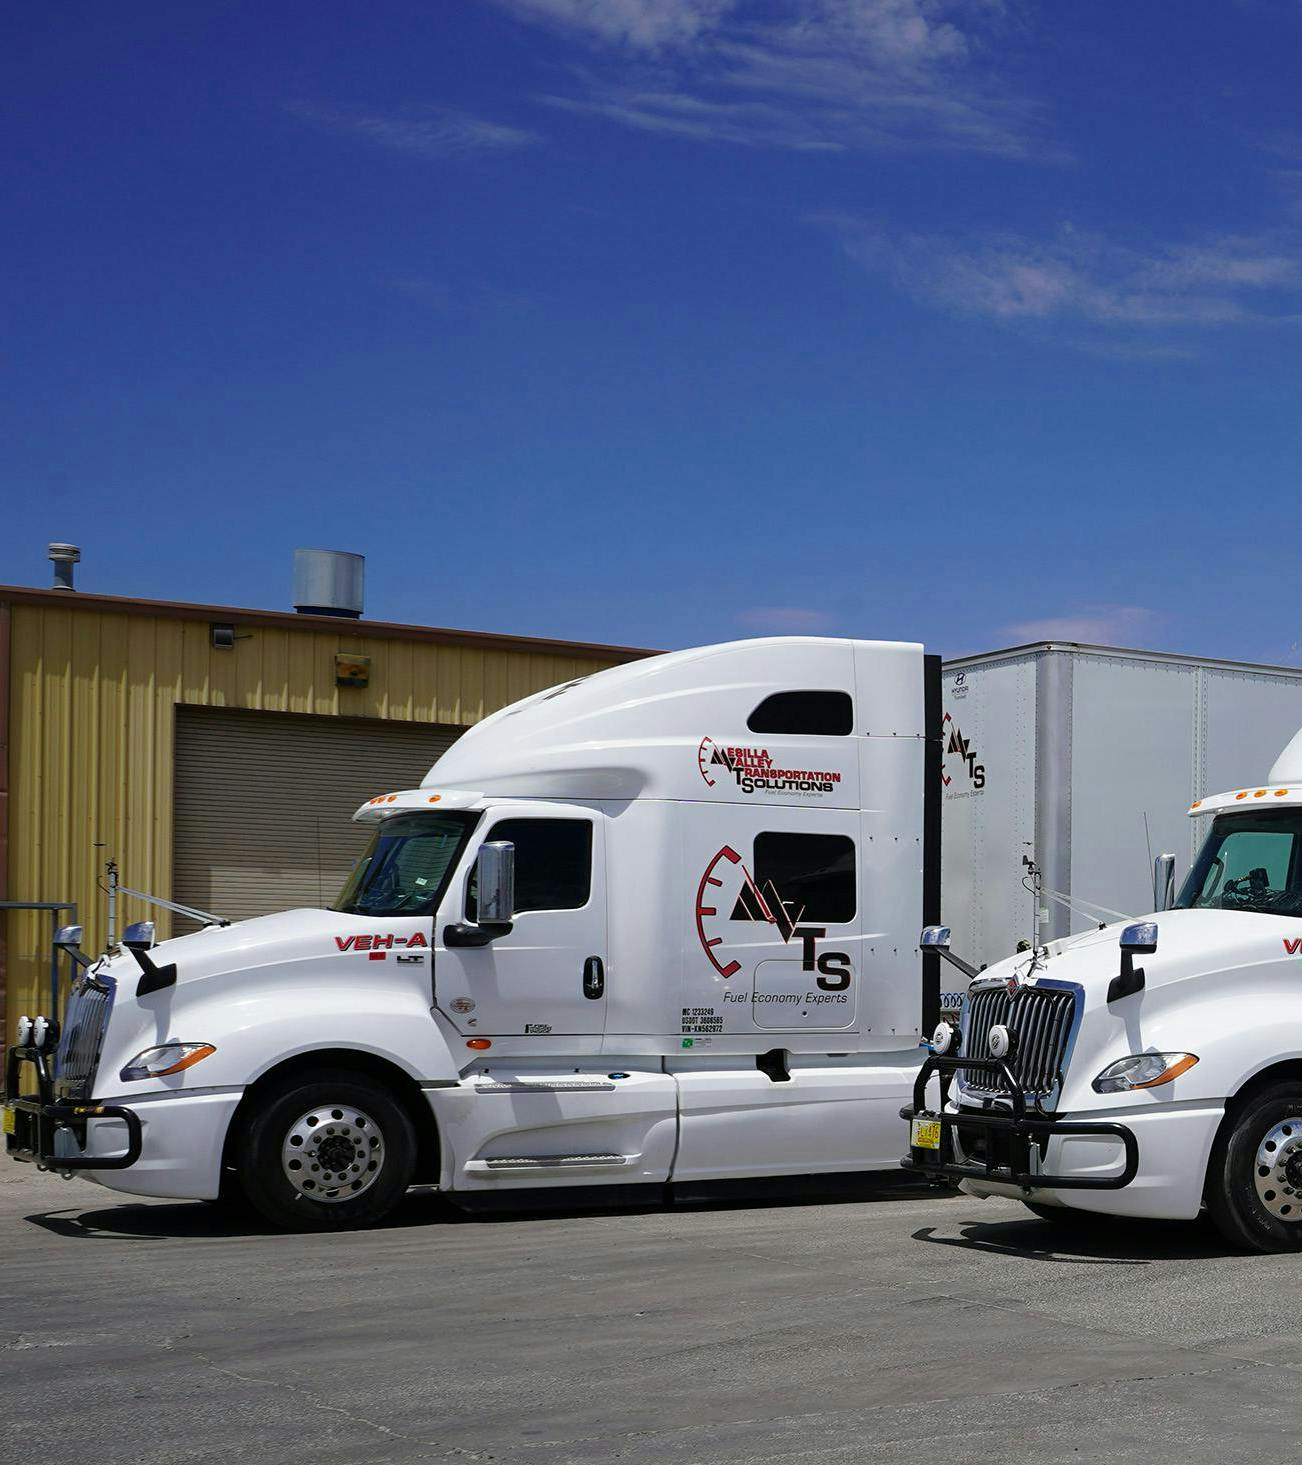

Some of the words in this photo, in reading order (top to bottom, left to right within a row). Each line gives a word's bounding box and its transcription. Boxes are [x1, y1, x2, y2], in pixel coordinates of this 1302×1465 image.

[733, 768, 841, 785] TRANSPORTATION
[741, 778, 833, 794] SOLUTIONS
[334, 932, 428, 951] VEH-A
[723, 991, 748, 1003] Fuel
[751, 992, 802, 1006] Economy
[801, 992, 848, 1006] Experts
[682, 1008, 691, 1016] MC
[682, 1016, 698, 1024] USDOT
